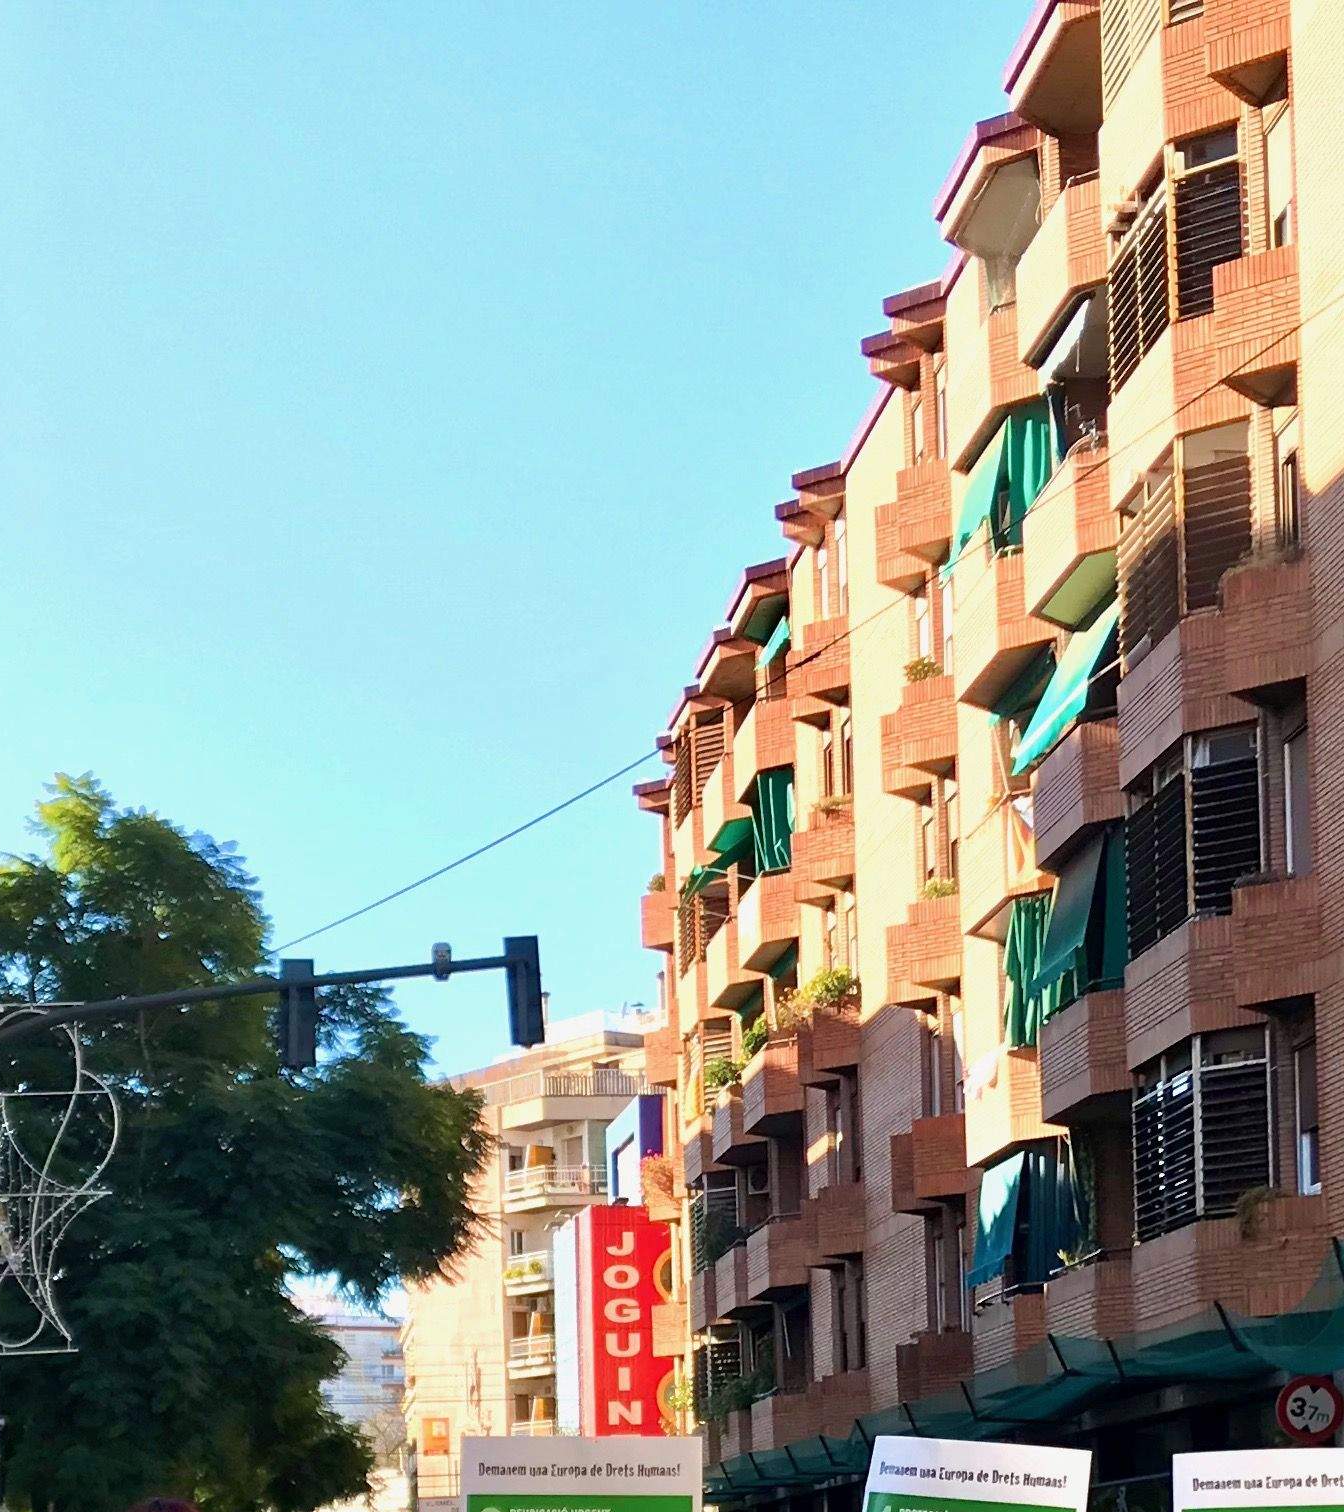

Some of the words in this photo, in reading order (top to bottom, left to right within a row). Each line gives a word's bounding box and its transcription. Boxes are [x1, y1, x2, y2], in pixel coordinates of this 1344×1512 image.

[603, 1231, 644, 1438] JOGUIN
[478, 1462, 527, 1477] Demanem
[529, 1464, 549, 1477] una
[550, 1463, 588, 1478] Europa
[590, 1463, 603, 1477] de
[605, 1462, 635, 1477] Drets
[637, 1463, 681, 1478] Humans!
[939, 1467, 974, 1482] Europa
[976, 1469, 989, 1483] de
[992, 1470, 1020, 1486] Drets
[1023, 1473, 1067, 1489] Humans!
[1192, 1477, 1242, 1491] Demanem
[1265, 1476, 1302, 1490] Europa
[1305, 1475, 1318, 1488] de
